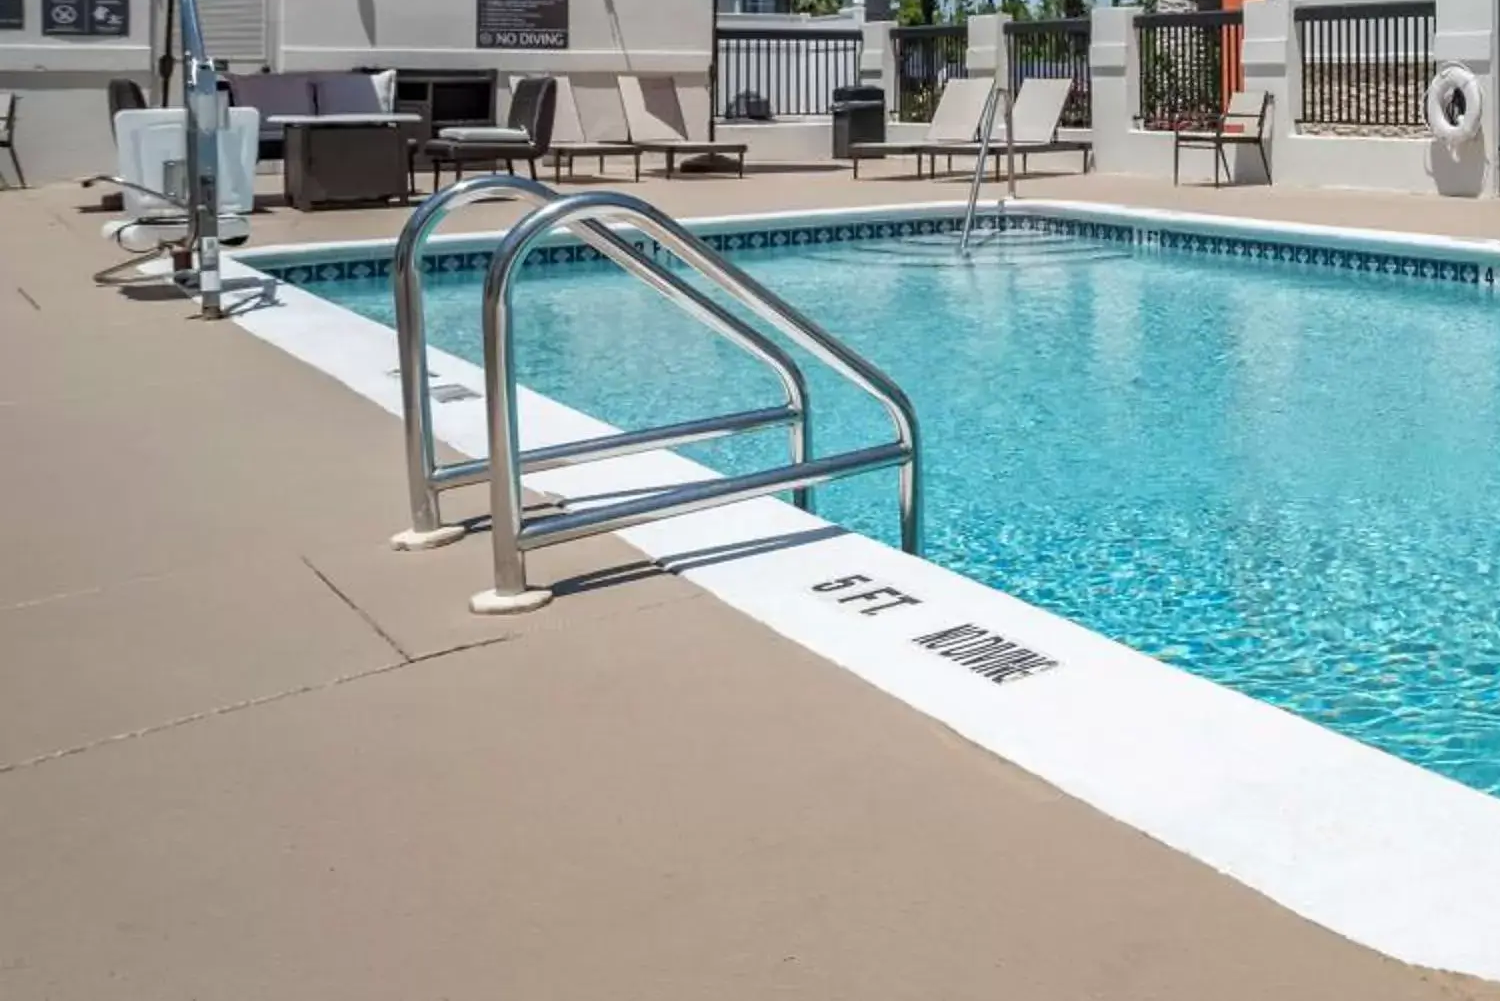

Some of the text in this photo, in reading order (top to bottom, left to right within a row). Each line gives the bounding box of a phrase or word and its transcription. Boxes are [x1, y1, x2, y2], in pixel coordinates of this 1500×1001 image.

[496, 32, 565, 46] NO DIVING
[1485, 267, 1494, 285] 4
[811, 574, 924, 616] 5 FT
